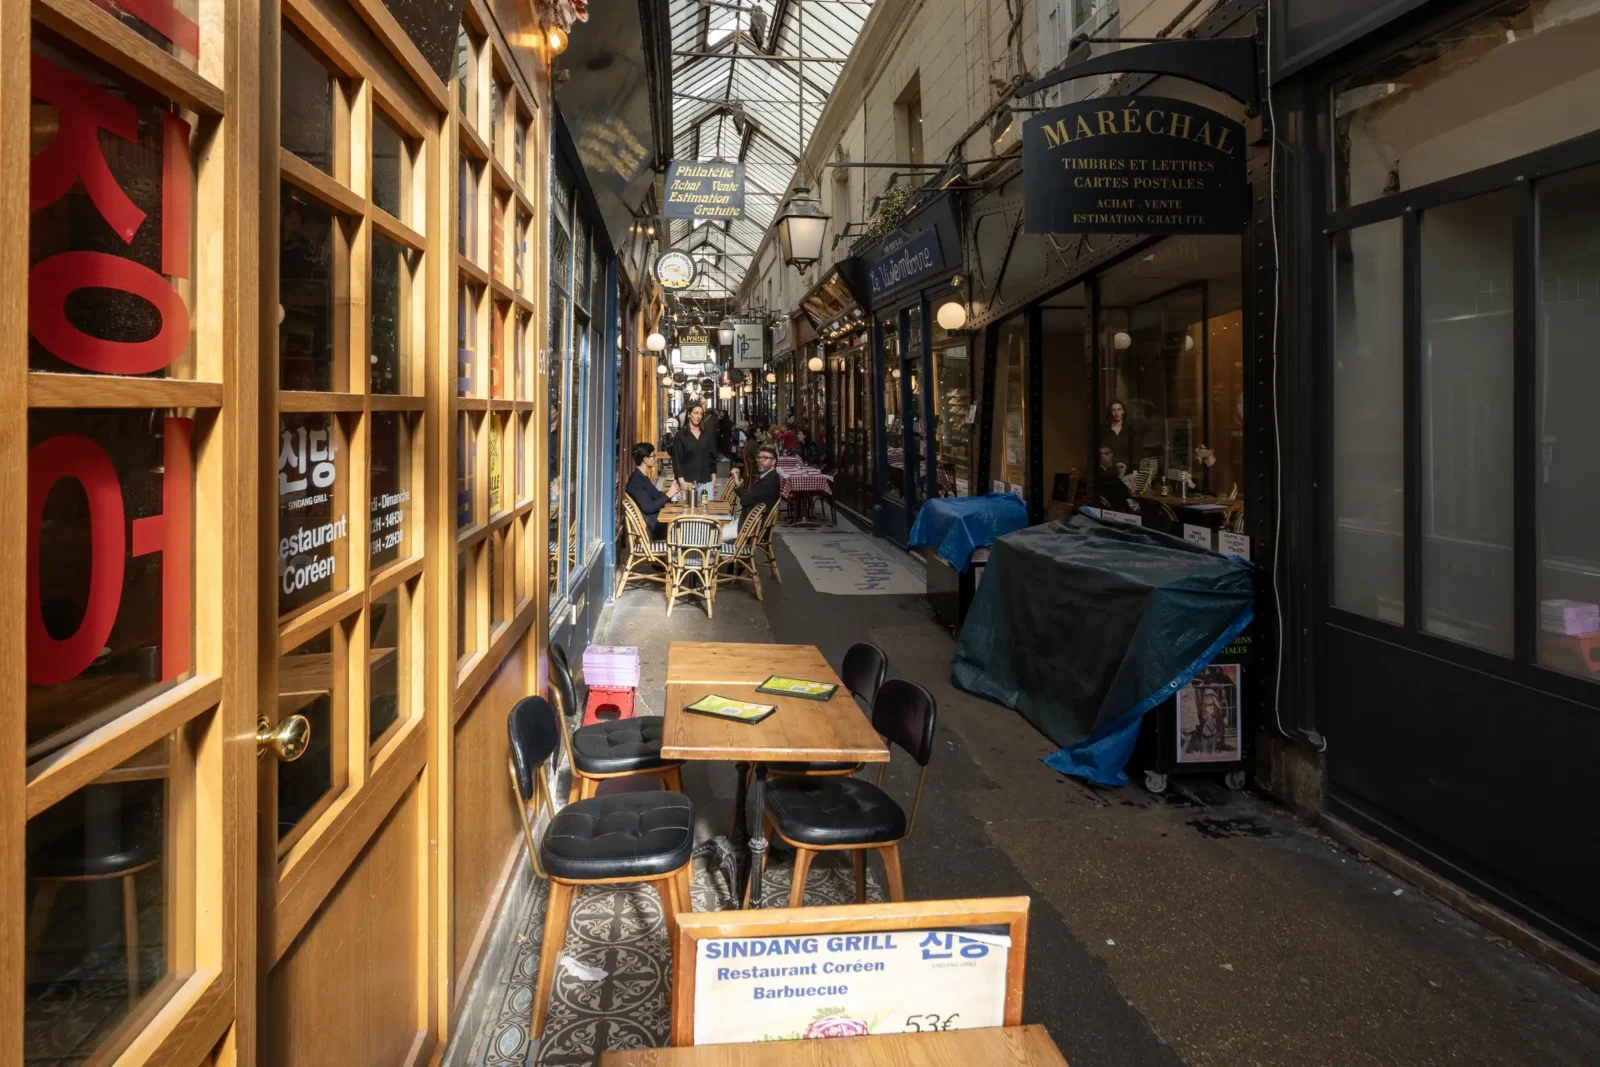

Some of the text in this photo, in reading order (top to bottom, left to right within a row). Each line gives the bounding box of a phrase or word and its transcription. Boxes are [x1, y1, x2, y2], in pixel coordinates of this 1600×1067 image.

[1040, 101, 1234, 155] MARÉCHAL
[675, 166, 735, 178] Philatélie
[1061, 158, 1214, 172] TIMBRES ET LETTRES
[670, 180, 739, 191] Achat Vente
[1074, 177, 1204, 190] CARTES POSTALES
[668, 191, 730, 204] Estimation
[1096, 199, 1135, 209] ACHAT
[1144, 199, 1183, 210] VENTE
[693, 204, 741, 216] Gratuite
[1073, 214, 1206, 225] ESTIMATION GRATUITE
[870, 270, 881, 293] Le
[279, 426, 339, 496] 신당
[288, 493, 328, 511] SINDANG GRILL
[370, 498, 378, 512] di
[381, 489, 410, 507] Dimanche
[371, 516, 382, 533] 2H
[279, 514, 347, 560] estaurant
[371, 536, 382, 555] 9H
[821, 540, 892, 591] WATERMAN
[282, 555, 336, 595] Coréen
[1222, 645, 1248, 654] TALES
[1231, 636, 1252, 645] IENS
[704, 933, 898, 960] SINDANG GRILL
[717, 958, 886, 981] Restaurant Coréen
[752, 982, 849, 1000] Barbuecue
[901, 1012, 961, 1033] 53€
